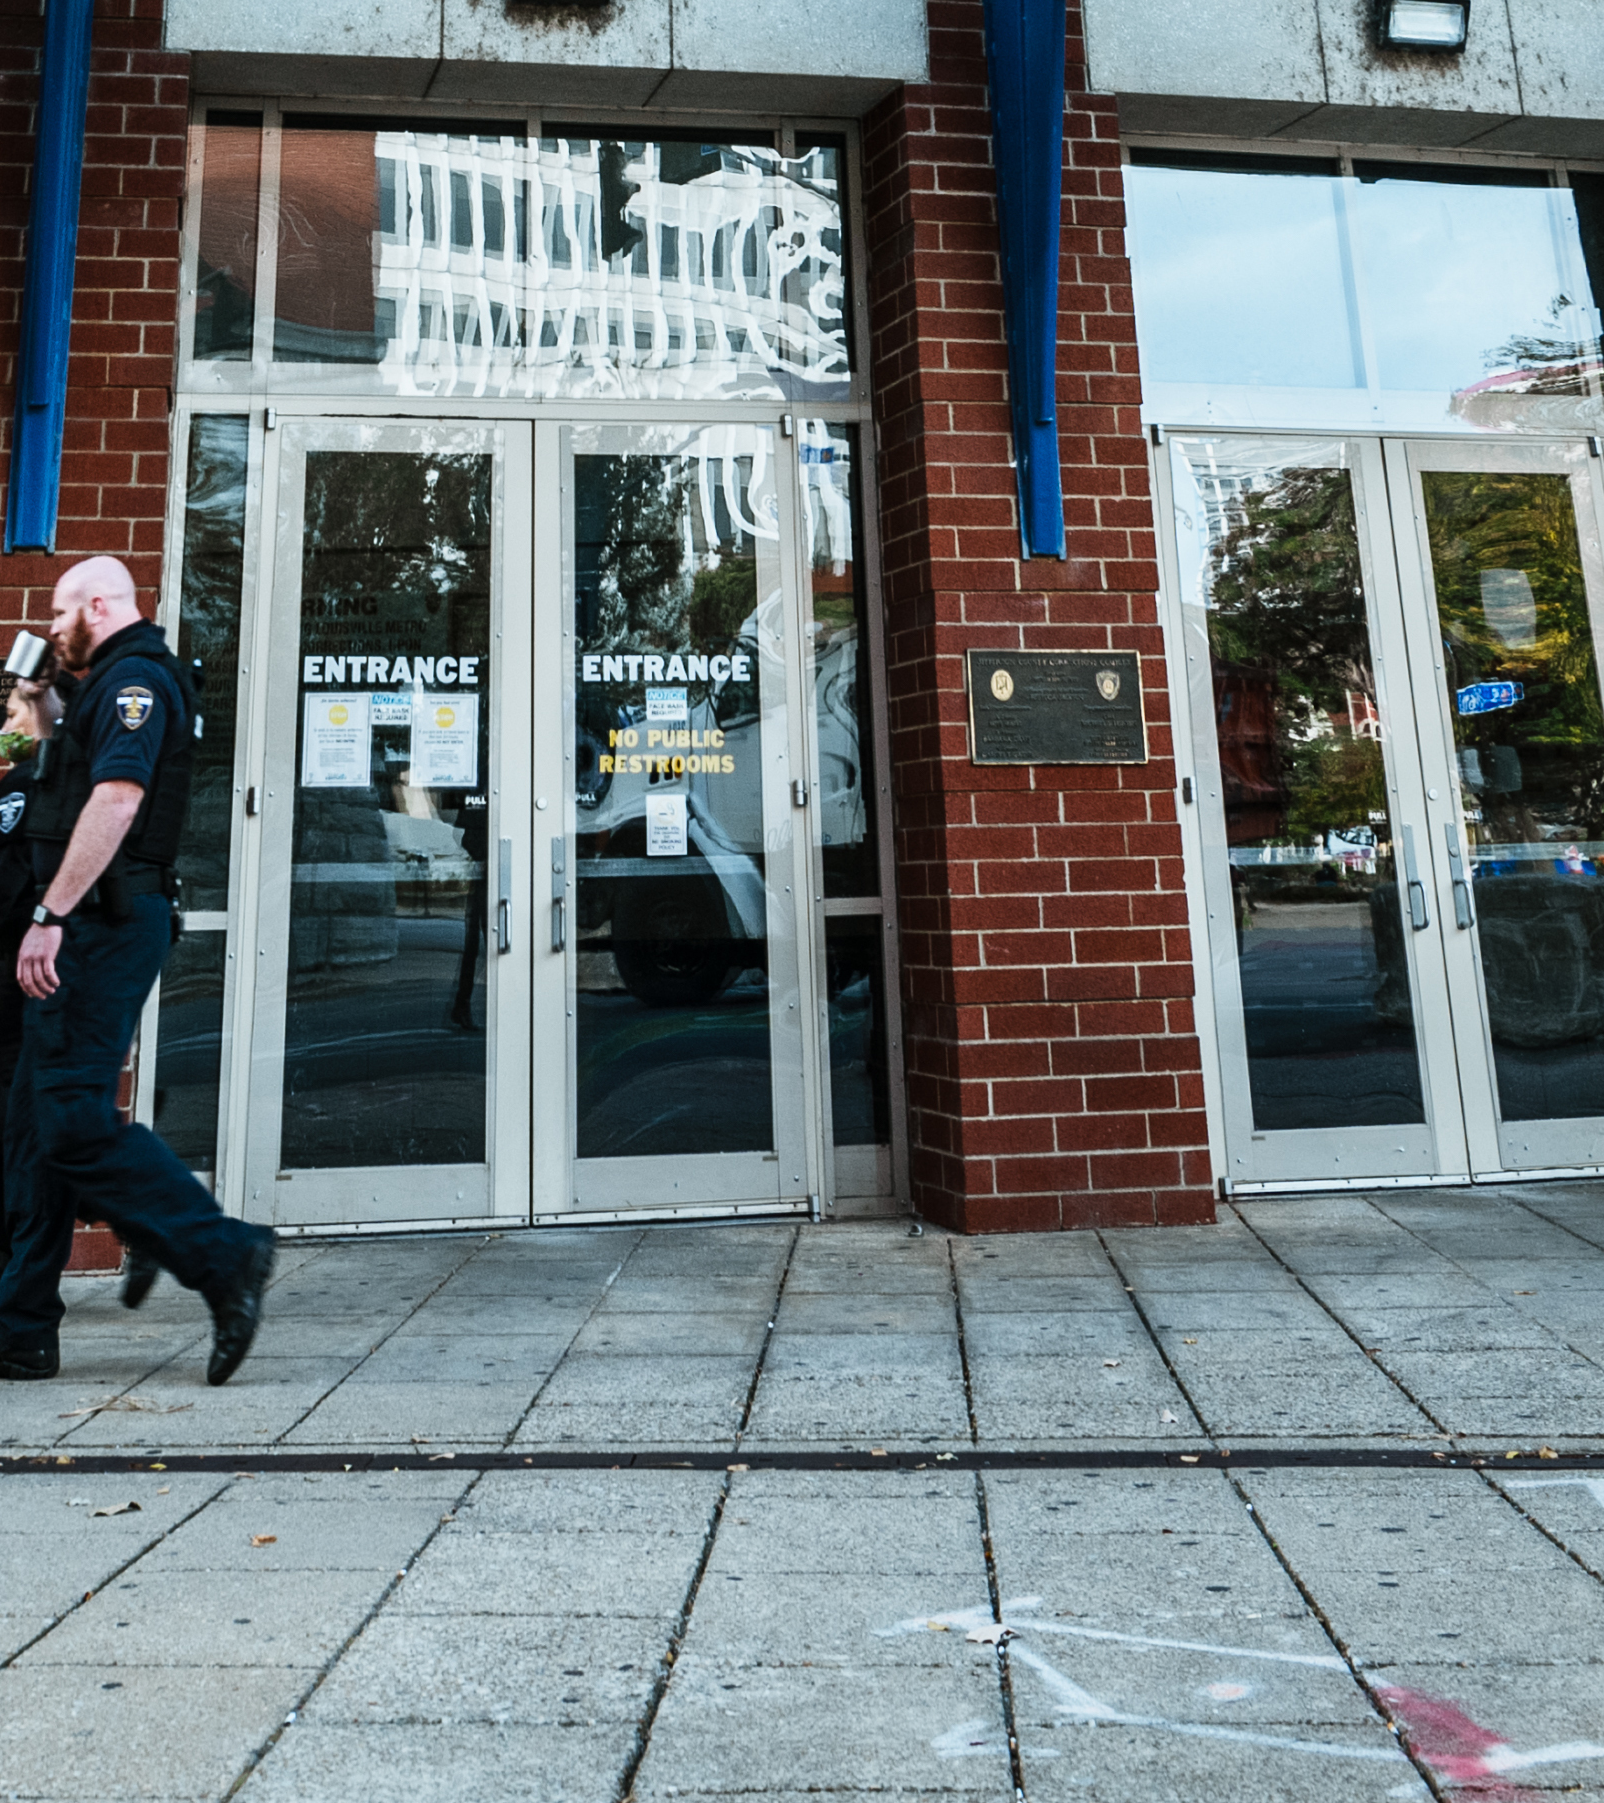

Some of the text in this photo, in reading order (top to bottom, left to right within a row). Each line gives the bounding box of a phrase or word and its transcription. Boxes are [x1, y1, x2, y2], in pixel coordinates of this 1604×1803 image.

[303, 655, 480, 684] ENTRANCE
[582, 654, 751, 682] ENTRANCE
[609, 729, 725, 748] NO PUBLIC
[599, 754, 735, 774] RESTROOMS
[464, 795, 487, 805] PULL
[575, 793, 596, 802] PULL
[1367, 809, 1387, 820] PULL
